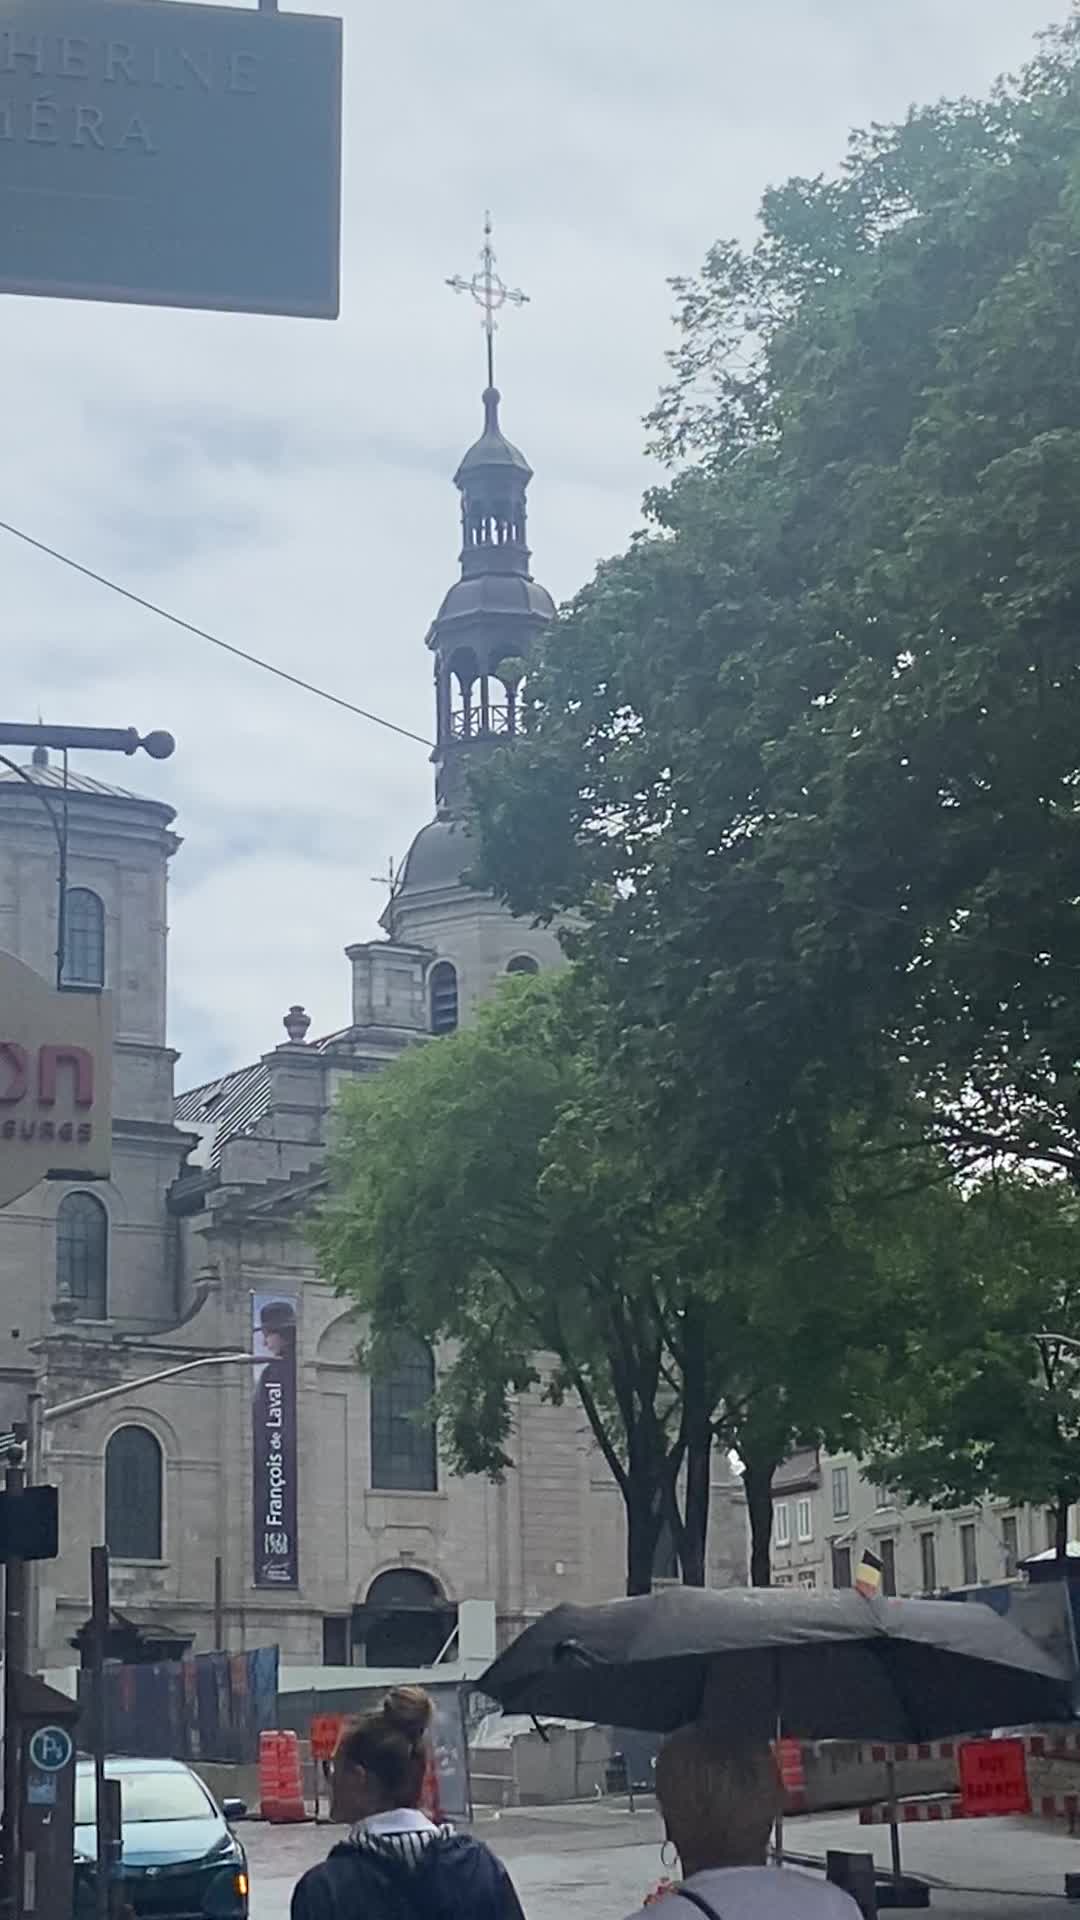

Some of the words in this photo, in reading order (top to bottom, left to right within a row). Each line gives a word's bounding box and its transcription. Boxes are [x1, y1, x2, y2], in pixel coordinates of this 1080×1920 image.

[265, 1382, 282, 1428] Laval
[270, 1431, 283, 1450] de
[265, 1452, 287, 1526] François
